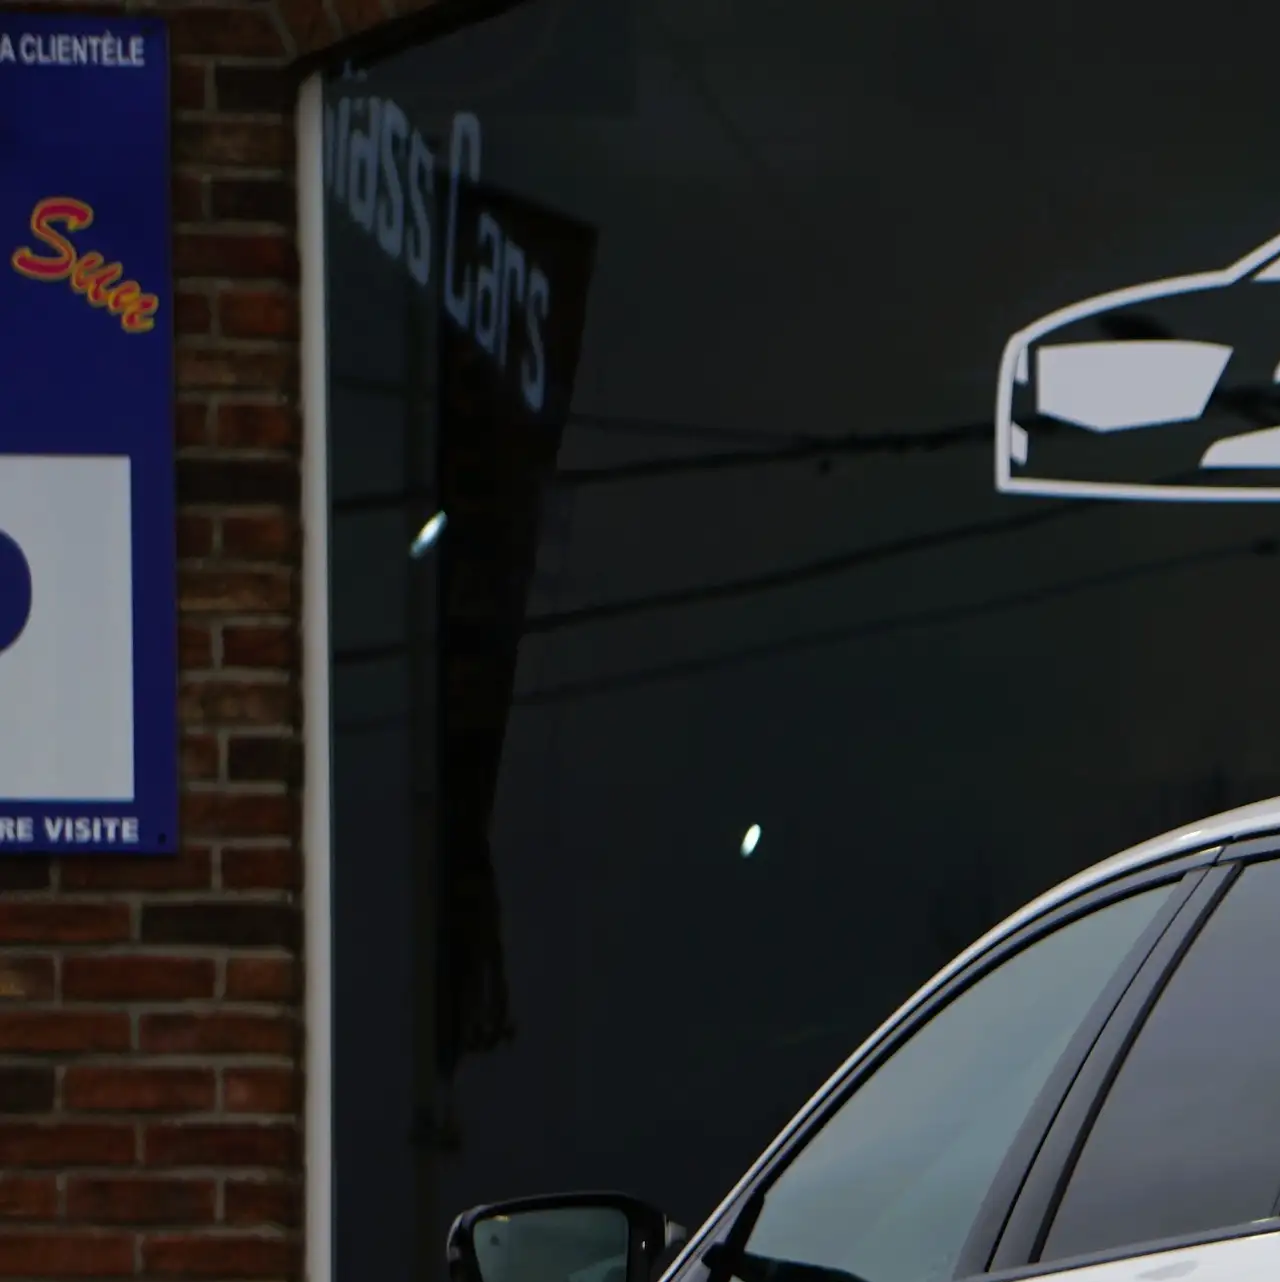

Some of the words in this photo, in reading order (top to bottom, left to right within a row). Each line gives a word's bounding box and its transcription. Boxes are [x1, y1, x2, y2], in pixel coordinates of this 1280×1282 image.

[19, 29, 145, 66] CLIENTÈLE
[324, 96, 434, 286] lass
[445, 111, 549, 413] Cars
[44, 817, 139, 843] VISITE
